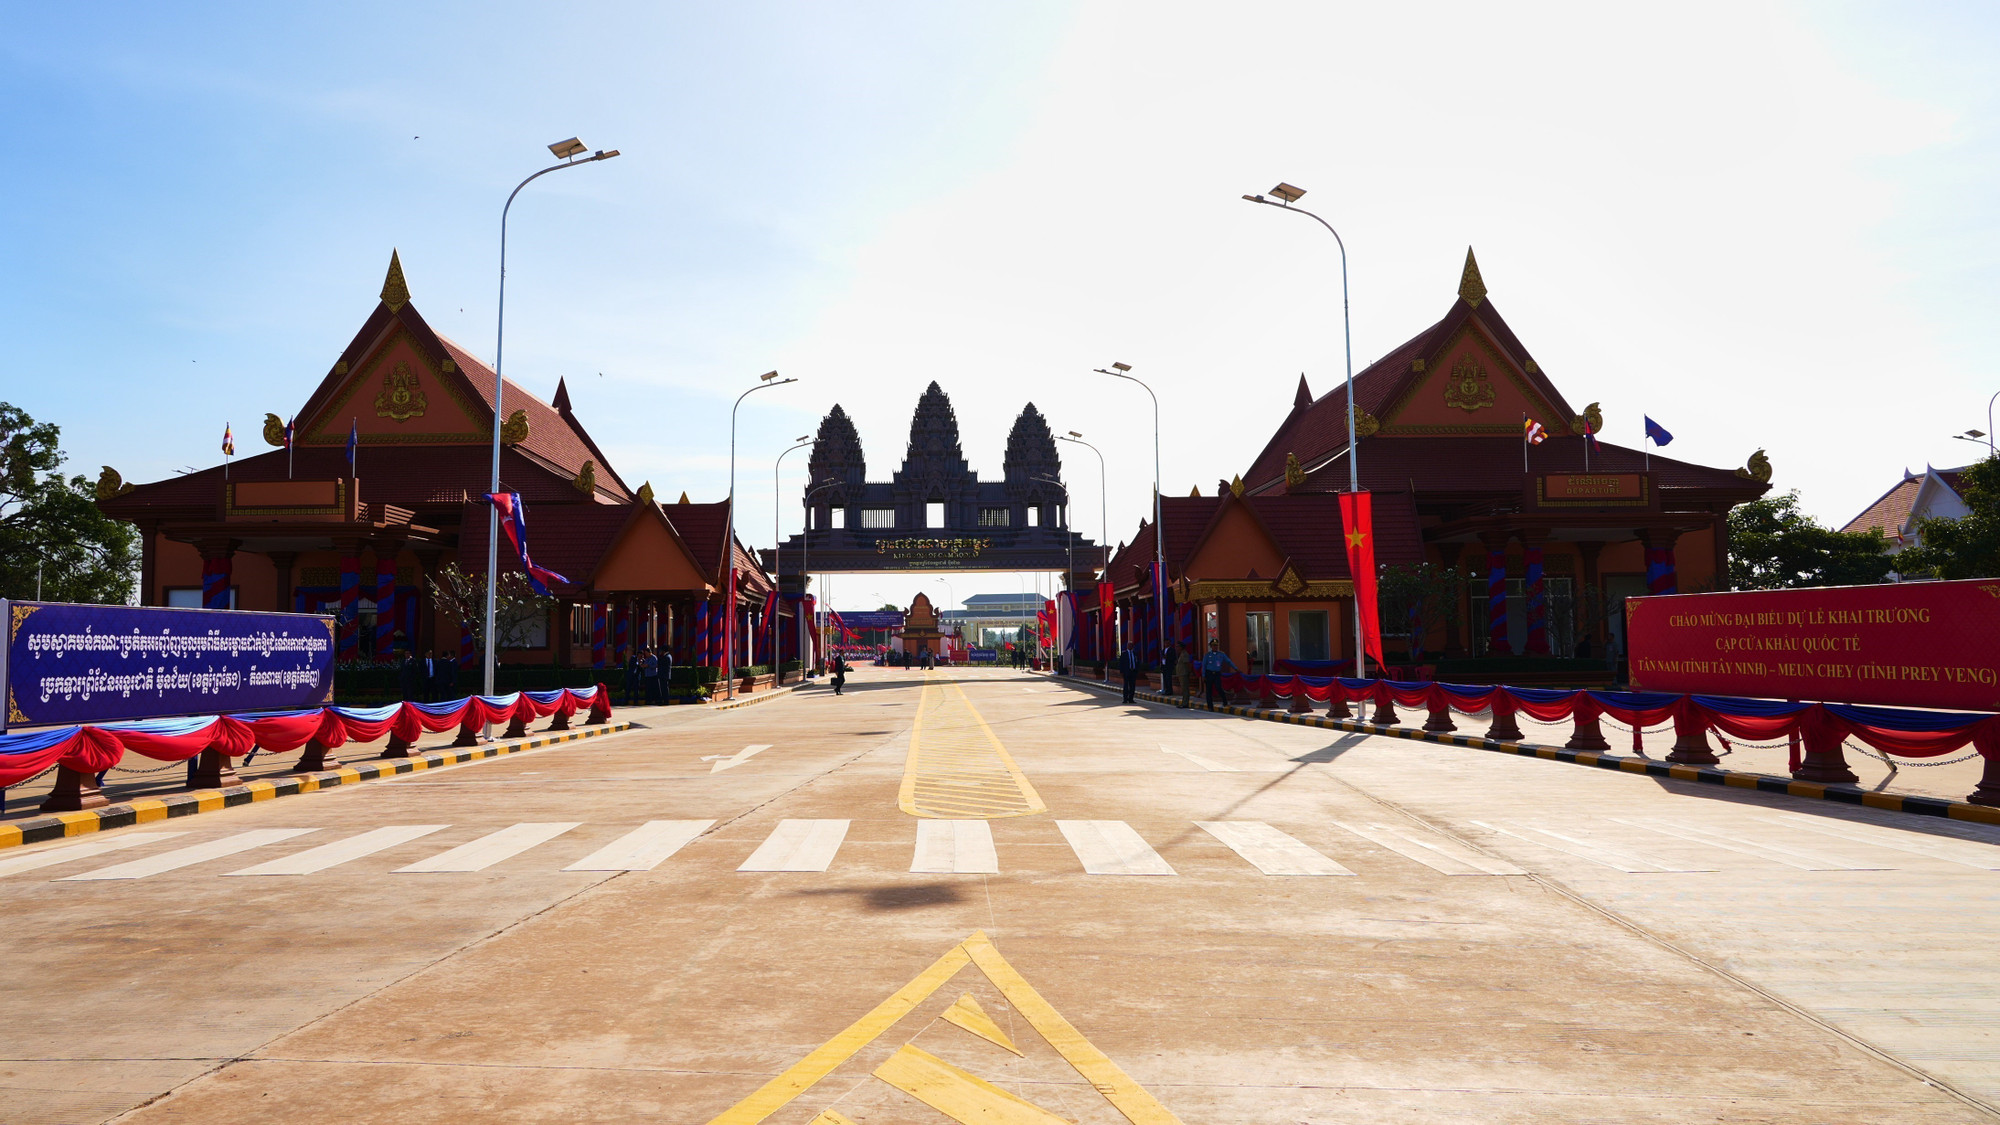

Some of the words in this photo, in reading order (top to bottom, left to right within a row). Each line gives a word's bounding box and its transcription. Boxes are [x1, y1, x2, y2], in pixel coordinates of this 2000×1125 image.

[1566, 487, 1622, 495] DEPARTURE
[1669, 612, 1698, 627] CHÀO
[1699, 610, 1733, 626] MỪNG
[1735, 612, 1755, 629] ĐẠI
[1757, 609, 1784, 625] BIỂU
[1788, 609, 1807, 628] DỰ
[1828, 609, 1863, 624] KHAI
[1865, 606, 1931, 624] TRƯƠNG
[1738, 634, 1763, 651] CỬA
[1802, 633, 1840, 654] QUỐC
[1842, 633, 1861, 651] TẾ
[1638, 656, 1657, 671] TÂN
[1657, 659, 1679, 673] NAM
[1711, 657, 1733, 674] TÂY
[1734, 662, 1768, 678] NINH)
[1777, 662, 1814, 677] MEUN
[1816, 663, 1854, 678] CHEY
[1900, 665, 1941, 682] PREY
[1944, 667, 1997, 687] VENG)
